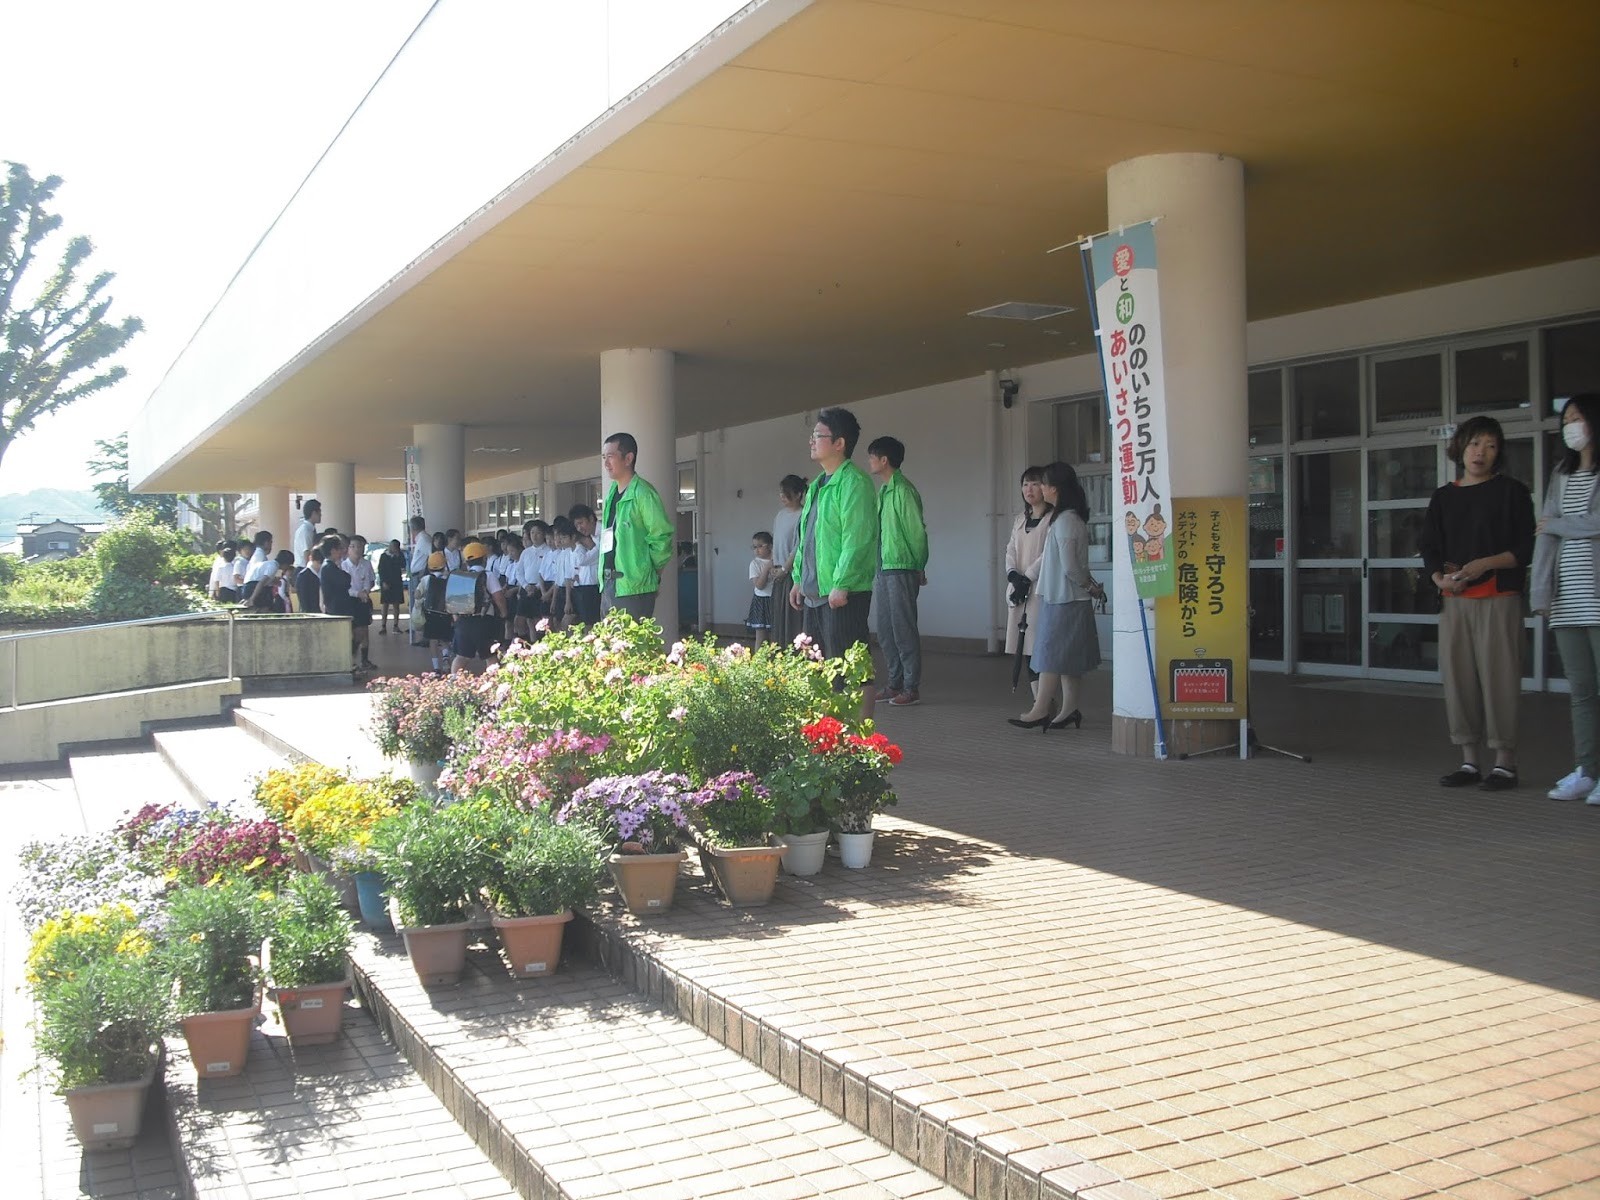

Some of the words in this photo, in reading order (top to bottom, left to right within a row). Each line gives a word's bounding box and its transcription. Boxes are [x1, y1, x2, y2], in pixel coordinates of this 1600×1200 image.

[1114, 247, 1132, 321] 愛と和
[1110, 329, 1138, 506] あいさつ運動
[1129, 323, 1160, 503] ののいち5万人
[1178, 562, 1199, 637] 危険から
[1205, 510, 1226, 615] 子どもを守ろう
